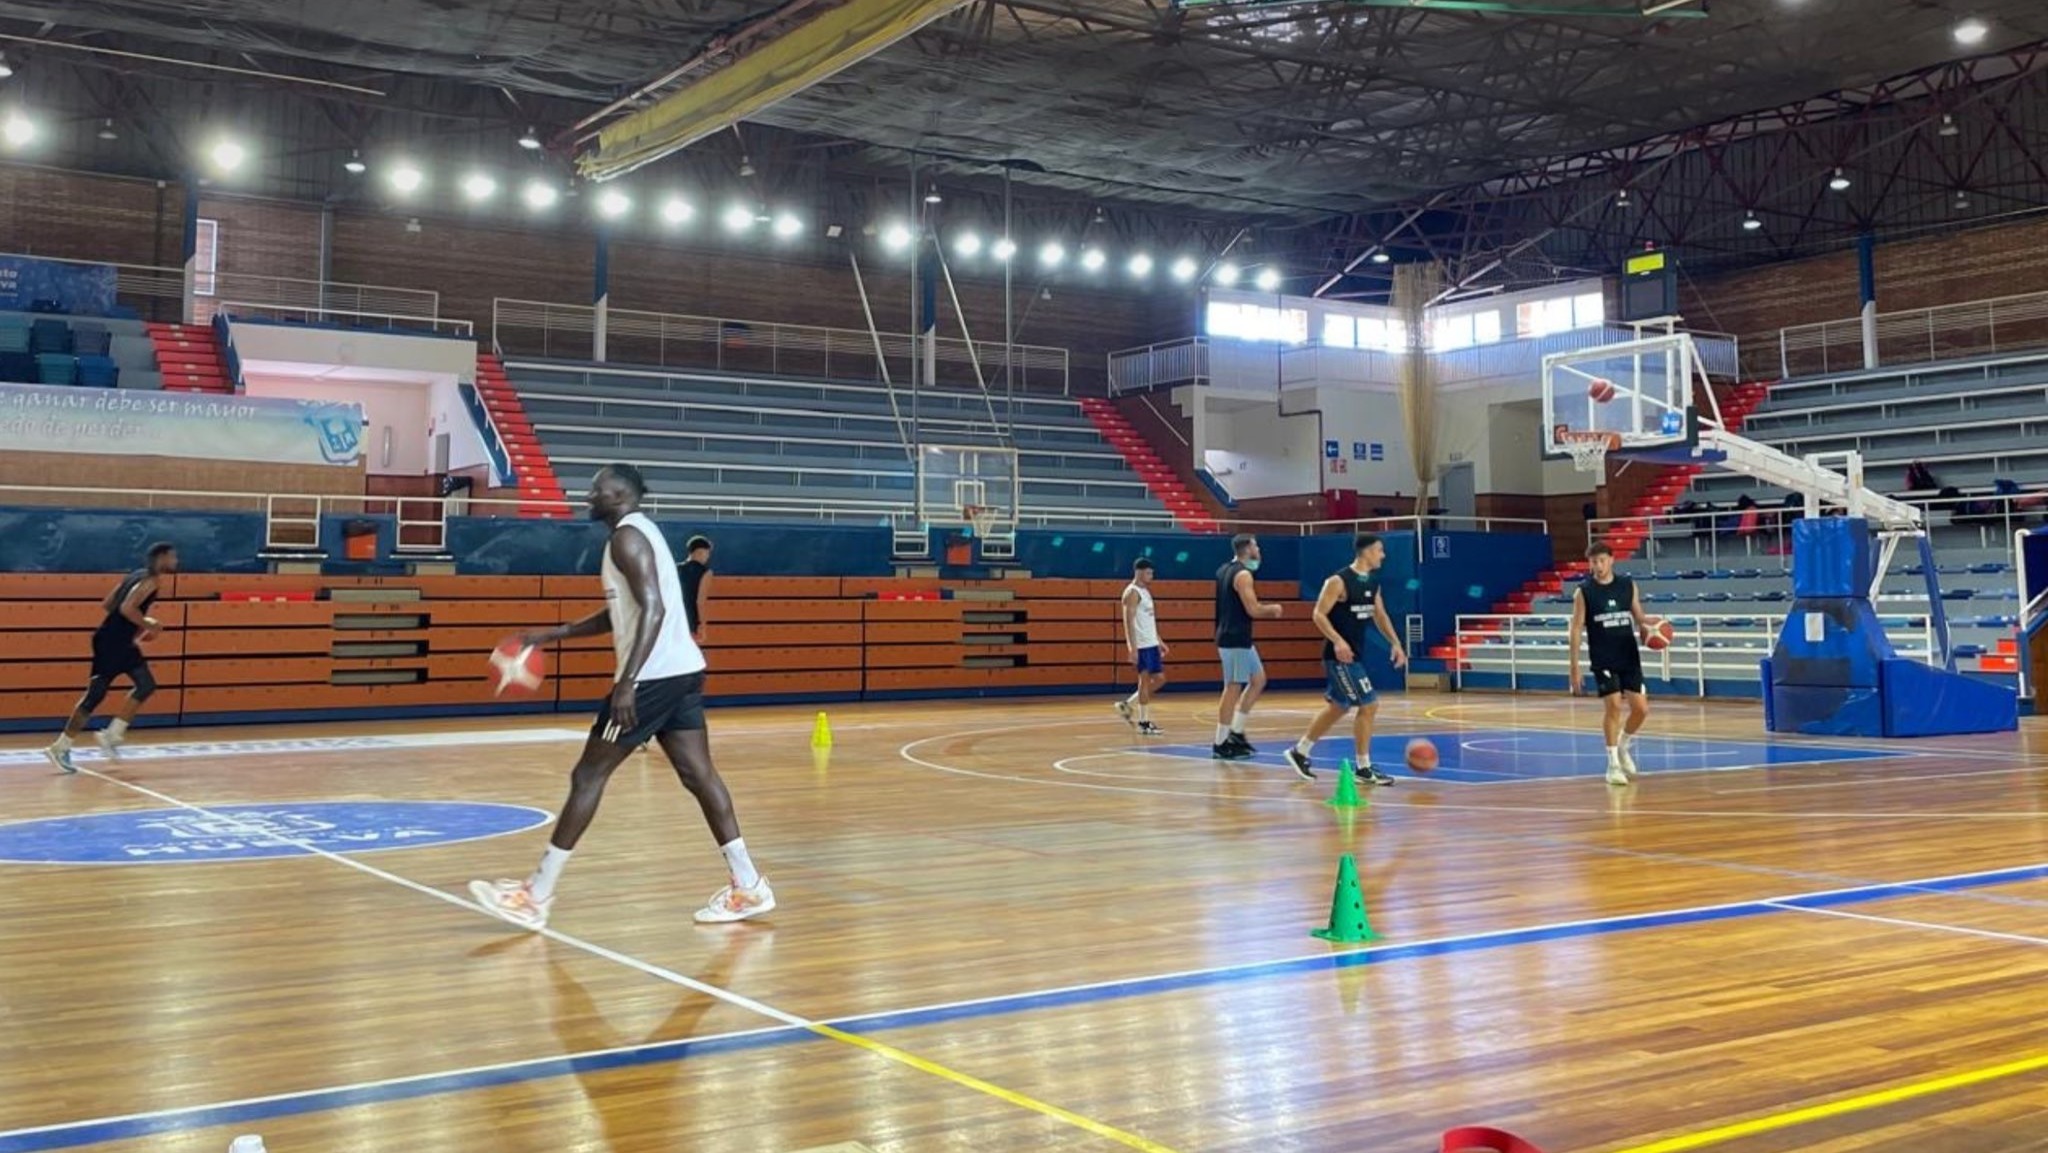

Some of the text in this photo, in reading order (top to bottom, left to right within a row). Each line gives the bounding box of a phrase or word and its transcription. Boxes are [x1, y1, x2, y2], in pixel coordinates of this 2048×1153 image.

[13, 392, 86, 413] ganar
[95, 389, 142, 412] debe
[148, 399, 178, 414] ser
